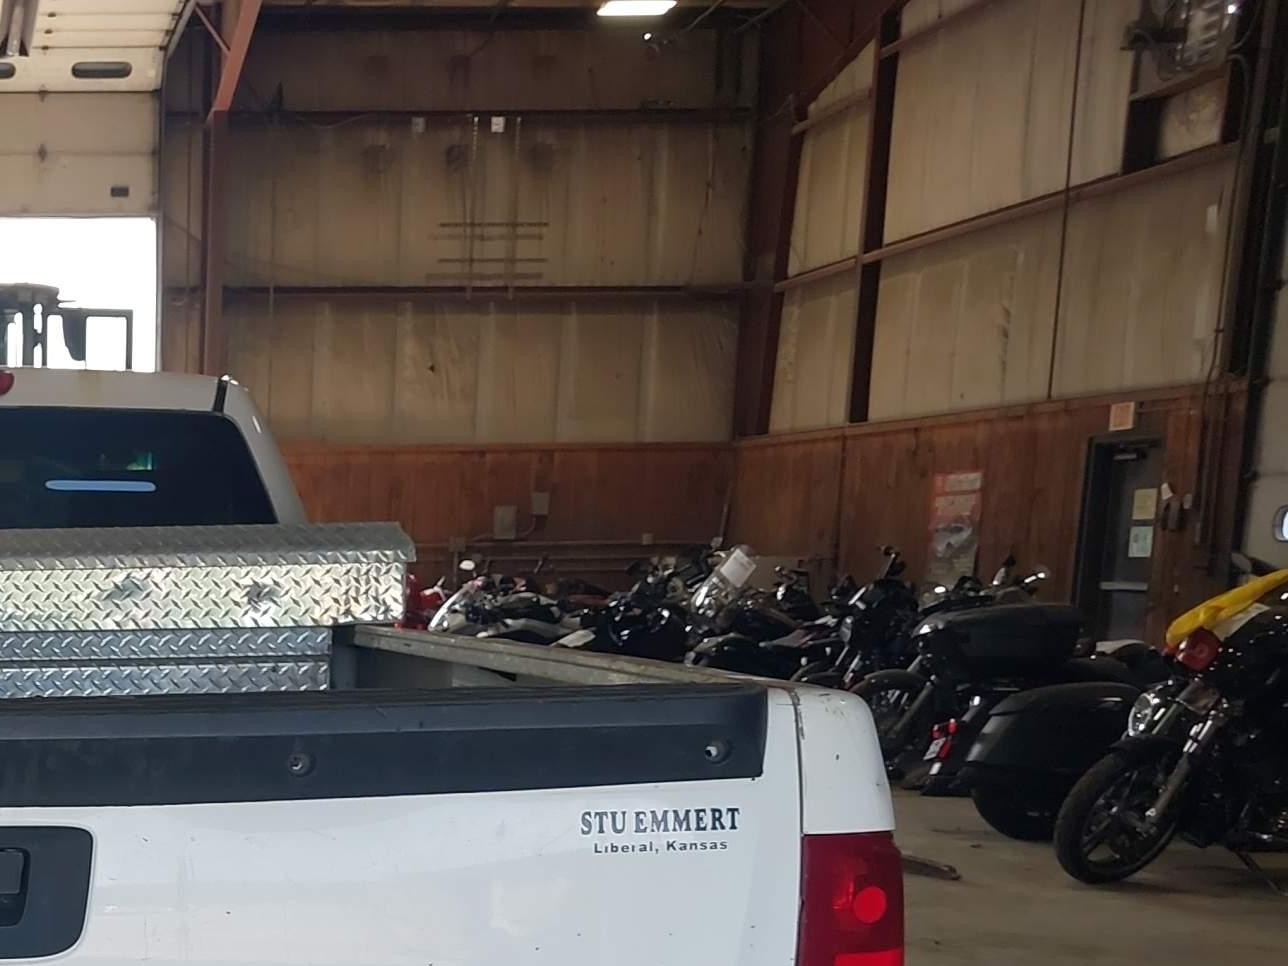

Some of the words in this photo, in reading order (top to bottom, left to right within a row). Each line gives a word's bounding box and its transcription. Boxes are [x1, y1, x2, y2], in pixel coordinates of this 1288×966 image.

[581, 811, 626, 835] STU
[634, 808, 740, 833] EMMERT
[594, 841, 659, 854] Liberal,
[666, 840, 728, 851] Kansas
